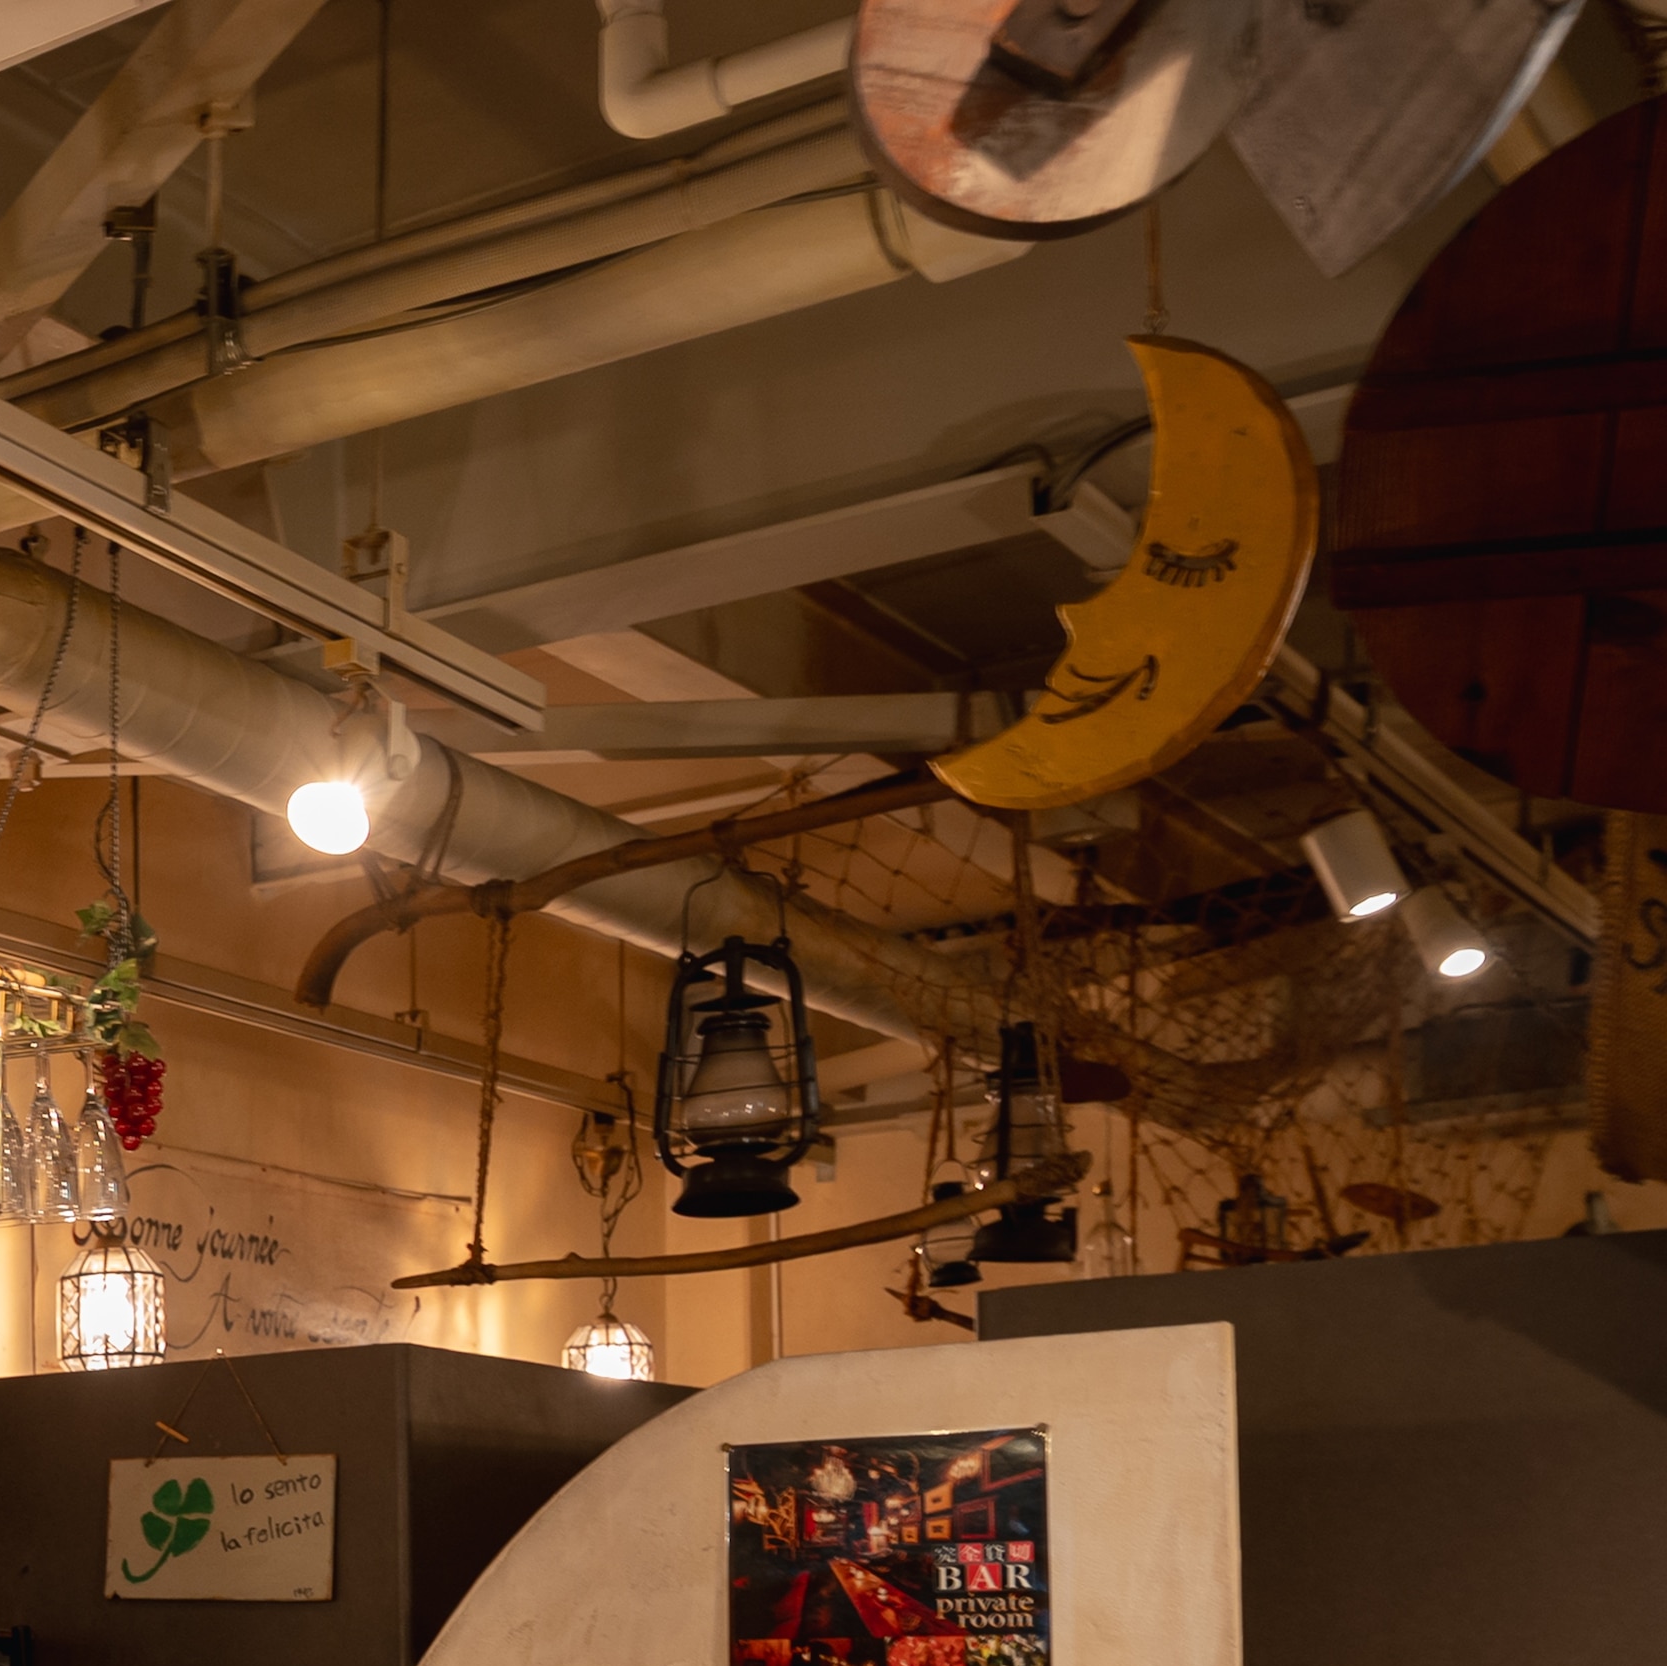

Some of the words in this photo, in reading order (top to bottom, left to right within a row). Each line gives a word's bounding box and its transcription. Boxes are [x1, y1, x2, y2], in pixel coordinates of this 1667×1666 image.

[264, 1473, 322, 1500] sento
[220, 1530, 242, 1552] la
[936, 1563, 1033, 1591] BAR
[935, 1592, 1035, 1619] private
[957, 1613, 1034, 1628] room
